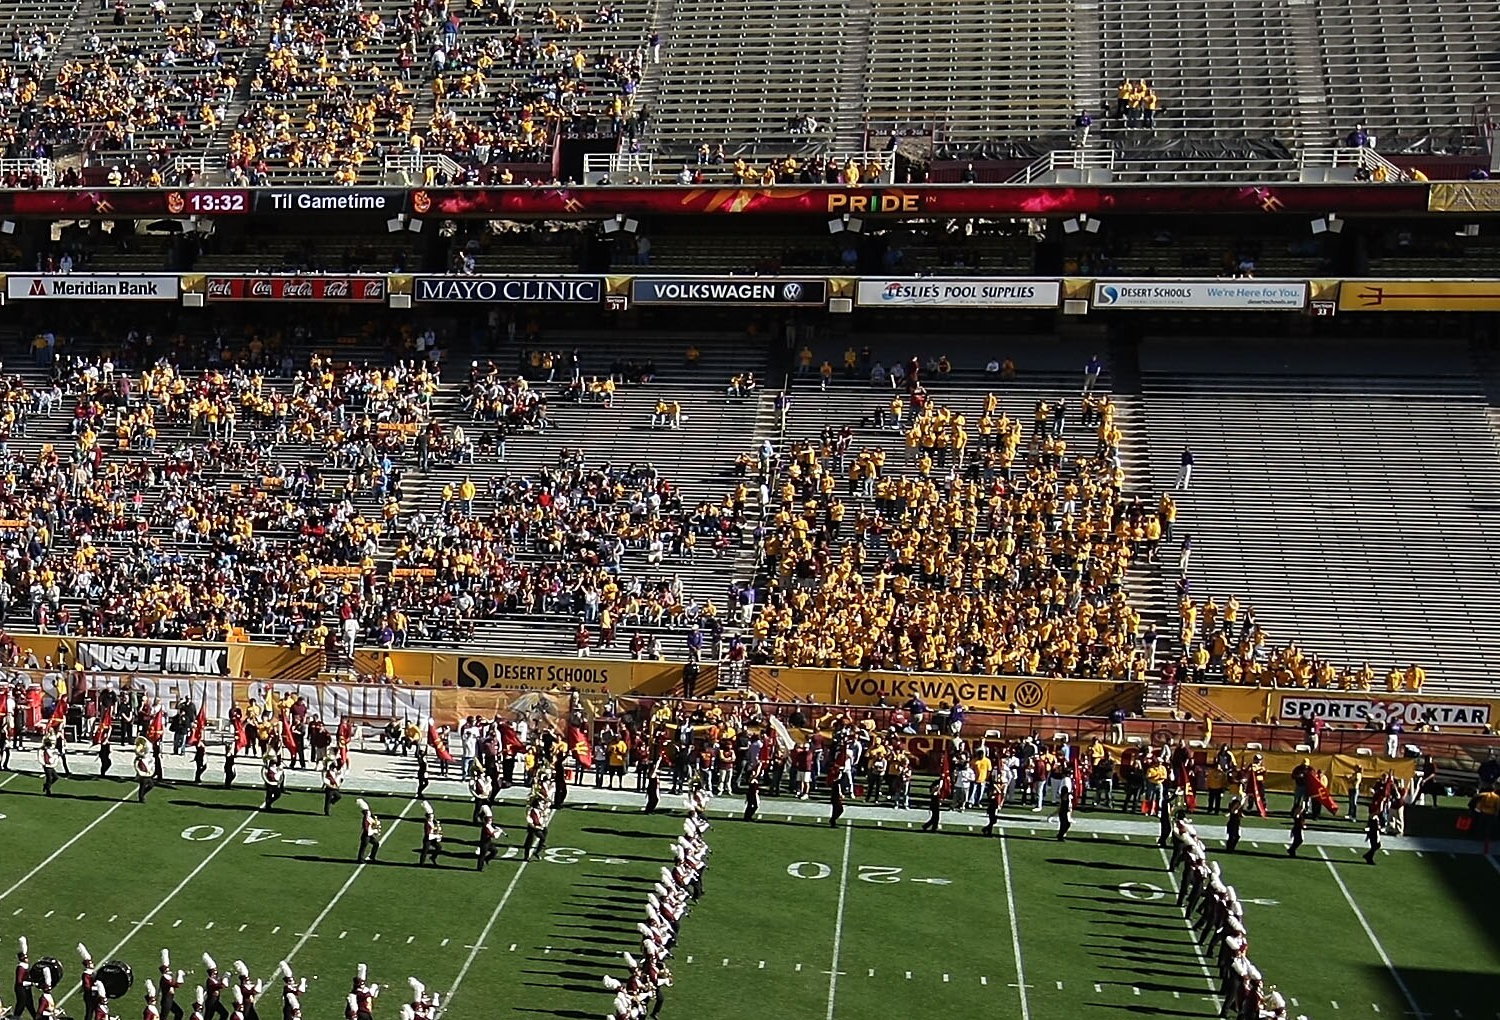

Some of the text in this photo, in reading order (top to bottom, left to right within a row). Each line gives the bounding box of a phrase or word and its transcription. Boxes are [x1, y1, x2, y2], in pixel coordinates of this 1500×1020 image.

[191, 195, 244, 210] 13:32
[272, 193, 386, 209] Til Gametime
[828, 193, 919, 212] PRIDE
[53, 280, 158, 296] Meridian Bank
[422, 281, 594, 300] MAYO CLINIC
[653, 284, 776, 299] VOLKSWAGEN
[944, 286, 977, 298] POOL
[981, 286, 1035, 298] SUPPLIES
[1121, 287, 1192, 298] DESERT SCHOOLS
[1207, 287, 1300, 298] We're Here for You.
[77, 642, 224, 675] MUSCLE MILK
[493, 662, 609, 684] DESERT SCHOOLS
[844, 677, 1007, 702] VOLKSWAGEN
[1284, 701, 1368, 719] SPORTS
[1369, 701, 1424, 725] 620
